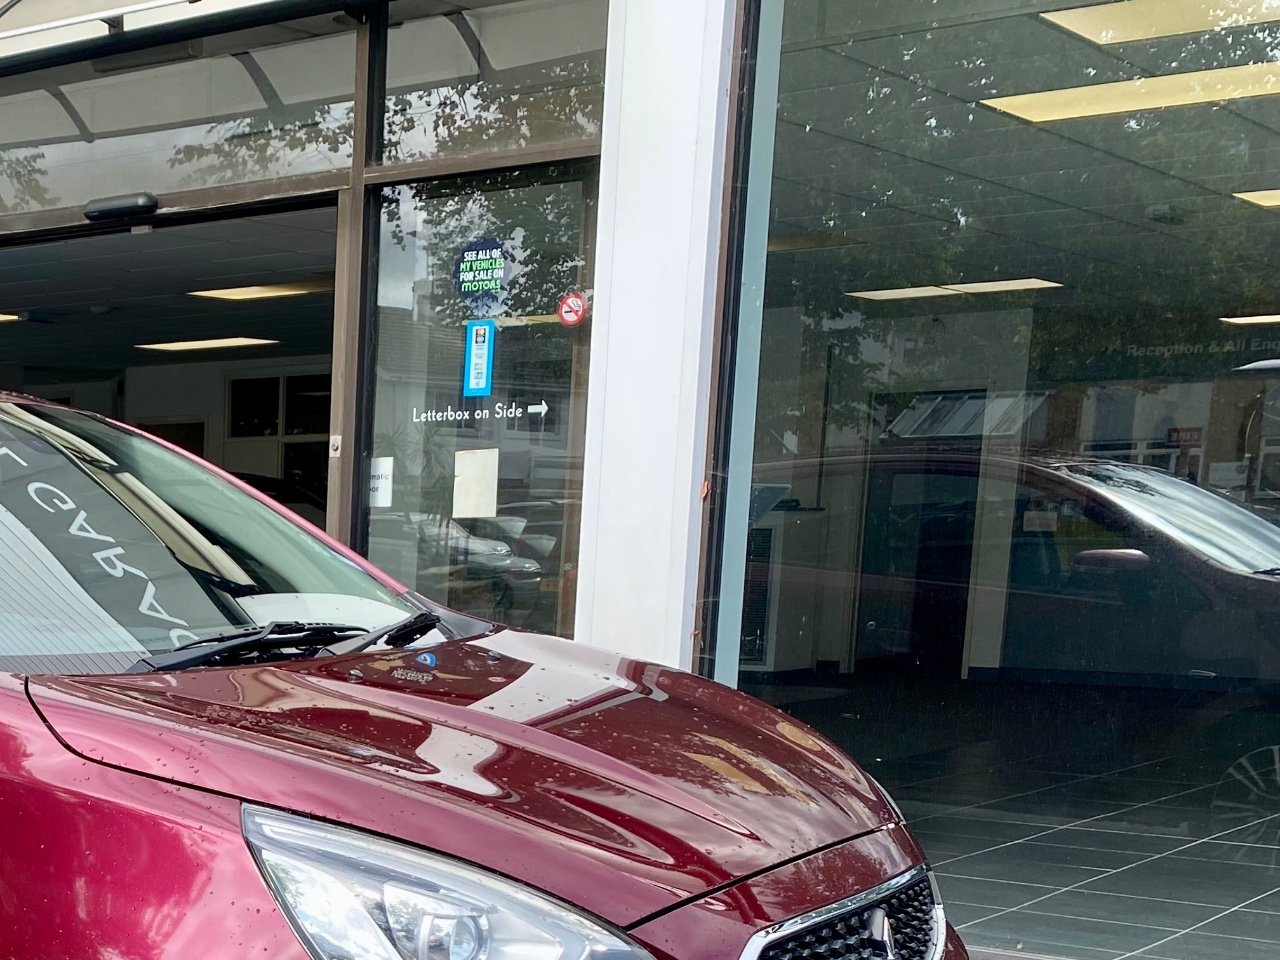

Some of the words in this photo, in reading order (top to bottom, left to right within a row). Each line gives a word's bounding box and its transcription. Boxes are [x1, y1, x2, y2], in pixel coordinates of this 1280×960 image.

[463, 250, 477, 261] SEE
[477, 249, 490, 260] ALL
[491, 248, 502, 258] OF
[460, 261, 471, 271] MY
[472, 258, 504, 270] VEHICLES
[460, 271, 474, 281] FOR
[474, 269, 492, 280] SALE
[493, 268, 504, 279] ON
[1127, 343, 1203, 358] Reception
[412, 405, 470, 422] Letterbox
[474, 409, 490, 419] on
[494, 402, 523, 418] Side
